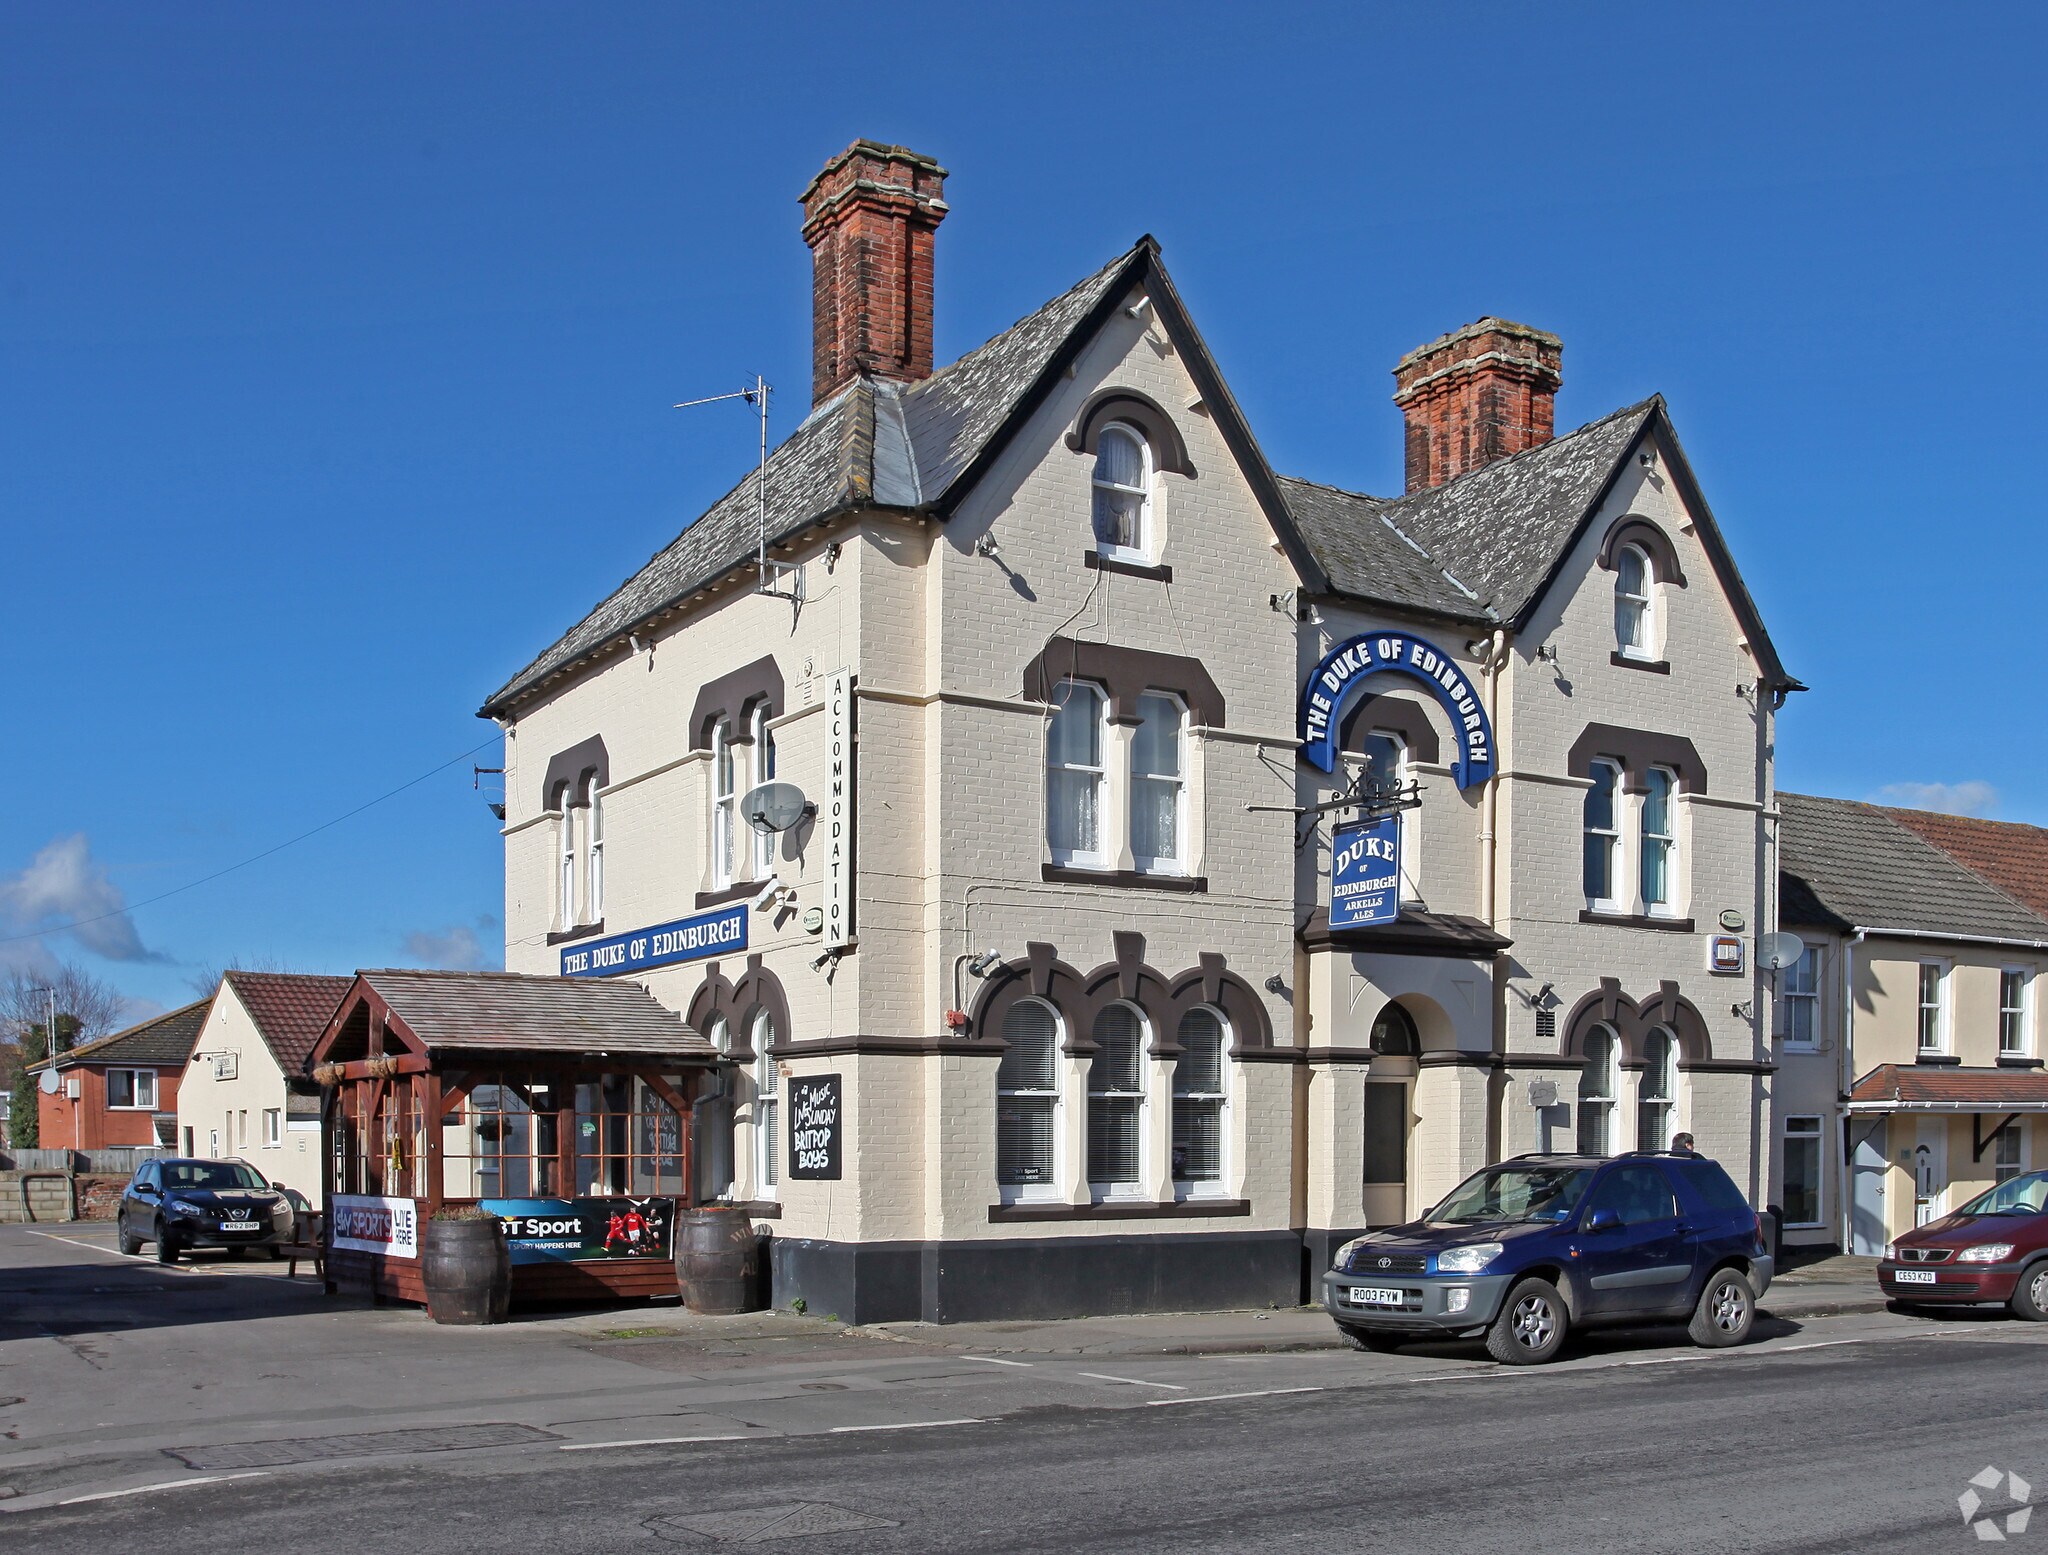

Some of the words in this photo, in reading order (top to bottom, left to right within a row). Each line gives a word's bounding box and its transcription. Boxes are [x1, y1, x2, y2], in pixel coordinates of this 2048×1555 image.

[1306, 692, 1332, 742] THE
[1321, 642, 1372, 694] DUKE
[1378, 638, 1402, 660] OF
[1410, 644, 1488, 762] EDINBURGH
[830, 678, 843, 942] ACCOMMODATION
[1336, 838, 1394, 876] DUKE
[1359, 864, 1368, 873] OF
[1333, 875, 1397, 898] EDINBURGH
[1345, 897, 1383, 911] ARKELLS
[1352, 909, 1374, 920] ALES
[564, 952, 588, 974] THE
[592, 943, 626, 968] DUKE
[630, 938, 647, 960] OF
[652, 916, 741, 957] EDINBURGH
[809, 1083, 831, 1112] MUSIC
[804, 1108, 836, 1127] SUNDAY
[794, 1127, 831, 1152] BRITPOP
[799, 1149, 829, 1169] BOYS
[353, 1211, 392, 1238] SPORTS
[394, 1209, 412, 1229] LIVE
[526, 1218, 582, 1238] Sport
[395, 1229, 412, 1246] HERE
[534, 1242, 564, 1250] HAPPENS
[565, 1241, 582, 1249] HERE
[1379, 1290, 1399, 1302] FYW
